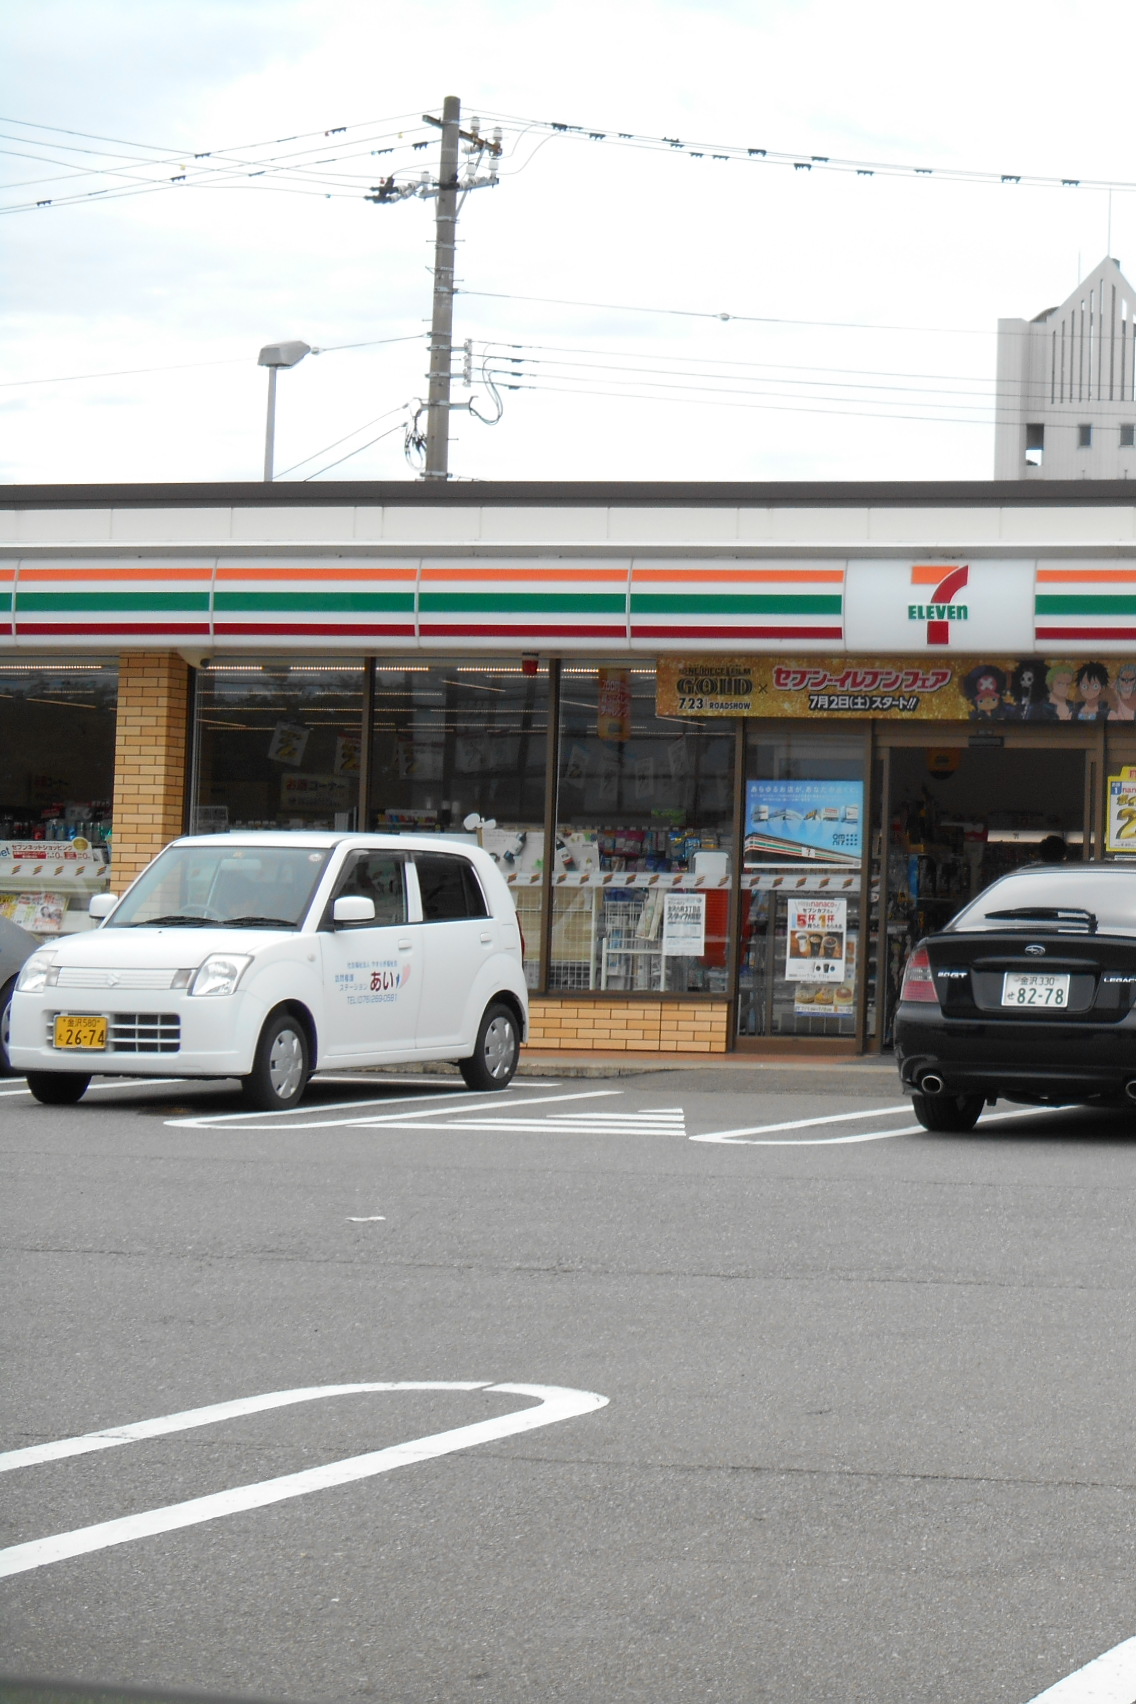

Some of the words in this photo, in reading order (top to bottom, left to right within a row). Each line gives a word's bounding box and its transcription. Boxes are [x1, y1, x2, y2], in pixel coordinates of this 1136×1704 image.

[709, 702, 751, 710] ROADSHOW
[370, 971, 394, 992] あい
[1017, 988, 1065, 1005] 82-78
[66, 1029, 105, 1046] 26-74
